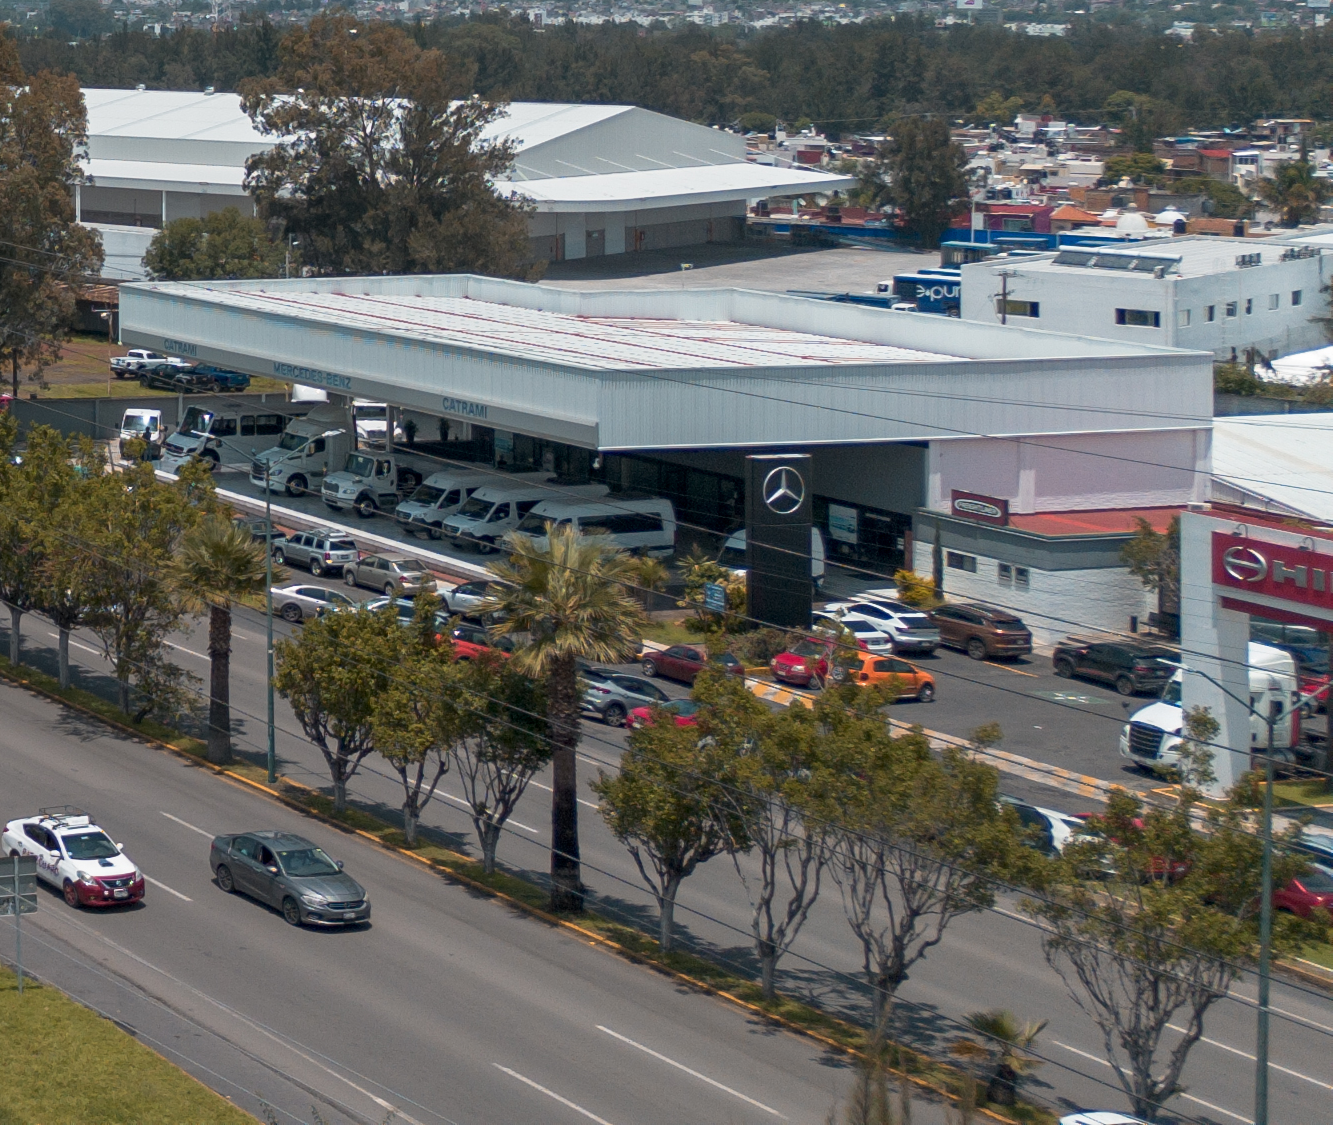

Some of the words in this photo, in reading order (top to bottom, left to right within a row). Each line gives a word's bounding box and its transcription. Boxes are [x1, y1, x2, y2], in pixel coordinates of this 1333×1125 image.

[163, 339, 198, 357] CATRAMI
[273, 361, 352, 390] MERCEDES-BENZ
[442, 397, 488, 419] CATRAMI
